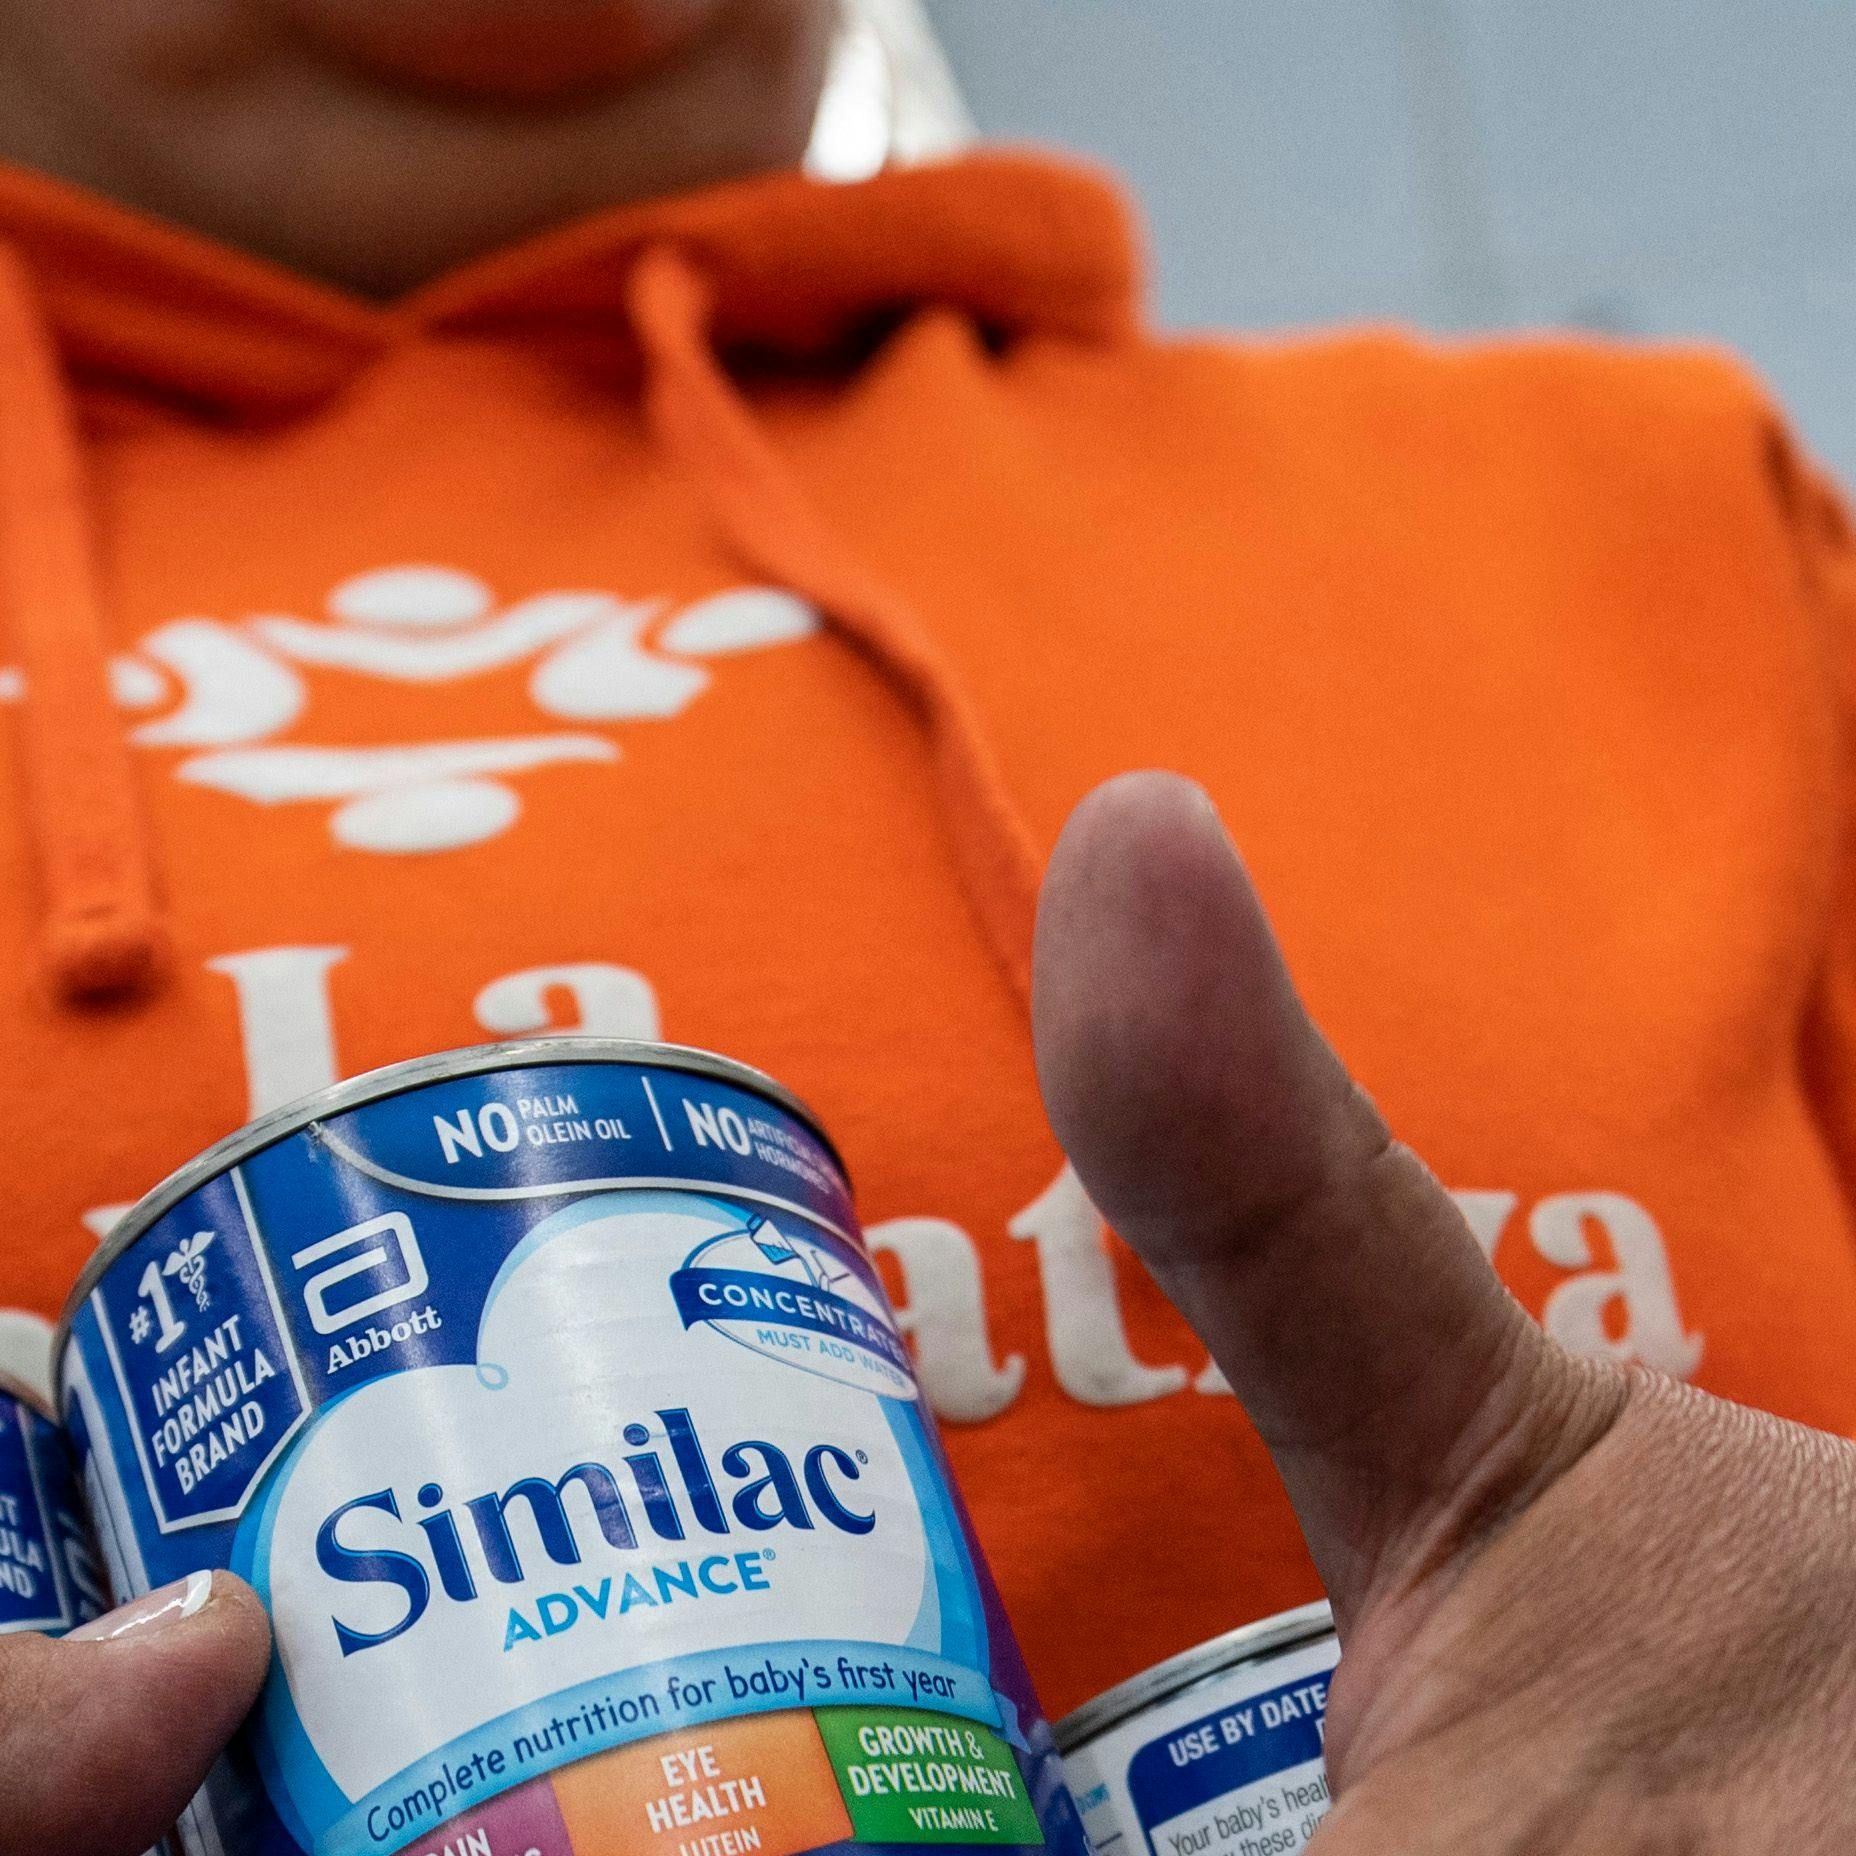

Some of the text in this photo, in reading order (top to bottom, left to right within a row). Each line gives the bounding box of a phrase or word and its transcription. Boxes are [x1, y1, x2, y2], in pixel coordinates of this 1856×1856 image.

[433, 1102, 520, 1165] NO
[518, 1093, 580, 1119] PALM
[525, 1117, 632, 1147] OLEIN OIL
[681, 1097, 751, 1157] NO
[151, 1314, 243, 1418] INFANT
[326, 1305, 443, 1375] Abbott
[757, 1327, 811, 1352] MUST
[818, 1339, 856, 1364] ADD
[151, 1348, 276, 1469] FORMULA
[174, 1400, 267, 1496] BRAND
[366, 1656, 957, 1844] Complete nutrition for baby's first year
[857, 1725, 984, 1760] GROWTH &
[1167, 1729, 1220, 1767] USE
[1220, 1709, 1256, 1747] BY
[1259, 1682, 1327, 1730] DATE
[660, 1743, 722, 1789] EYE
[847, 1761, 1016, 1802] DEVELOPMENT
[645, 1776, 767, 1835] HEALTH
[908, 1806, 999, 1833] VITAMIN E
[1213, 1795, 1281, 1840] baby's
[1282, 1773, 1330, 1810] heal
